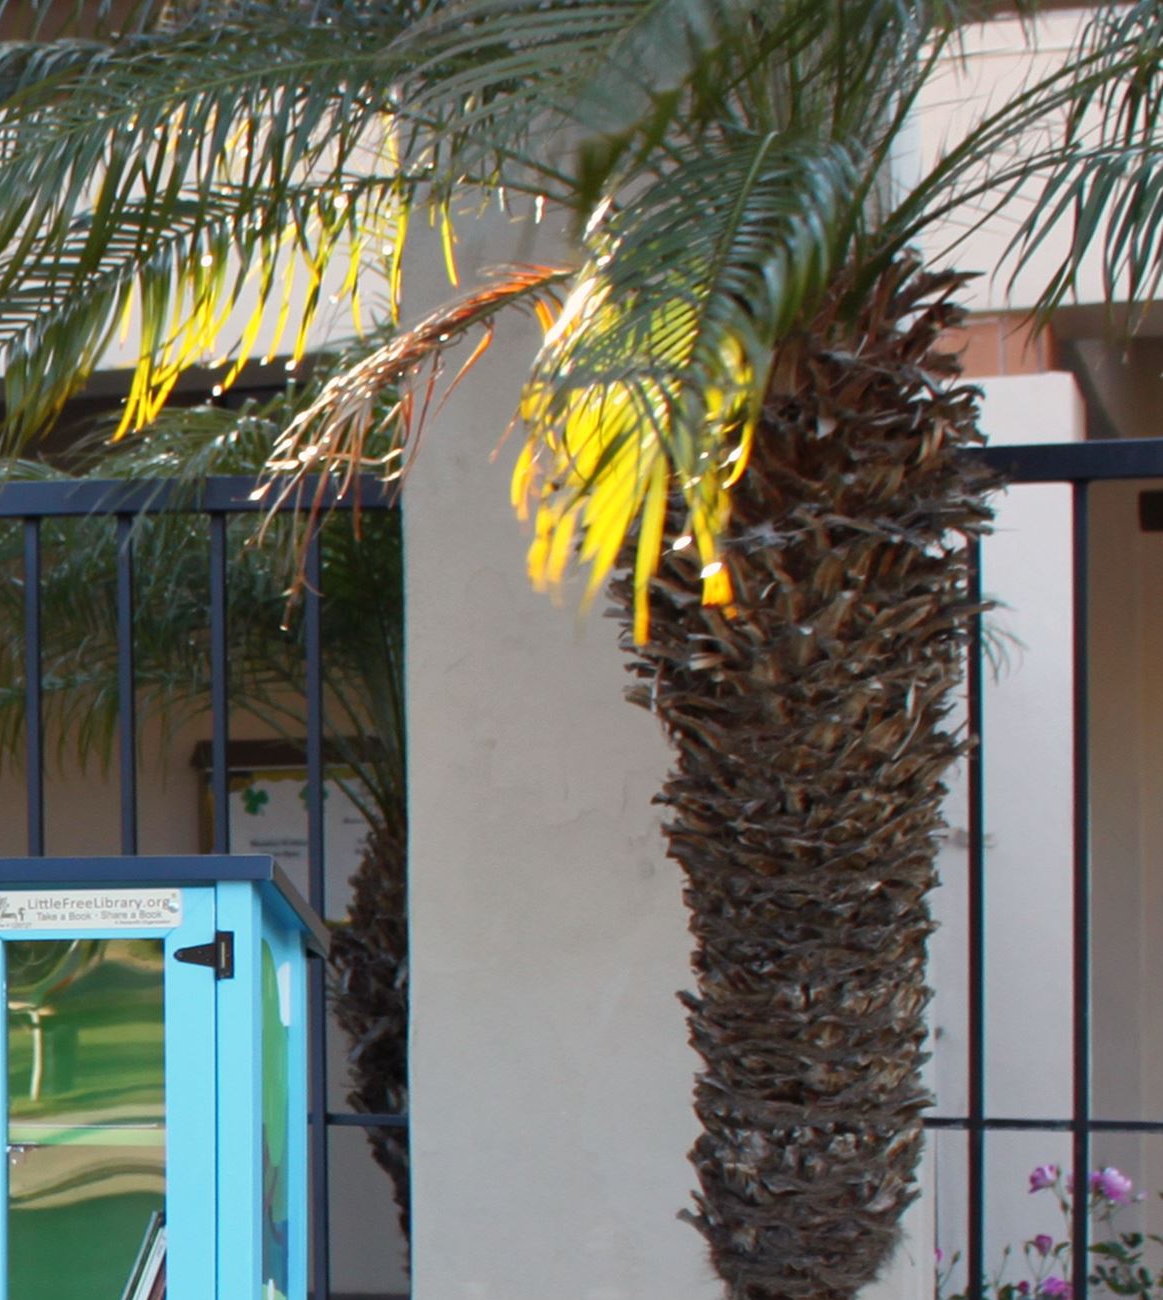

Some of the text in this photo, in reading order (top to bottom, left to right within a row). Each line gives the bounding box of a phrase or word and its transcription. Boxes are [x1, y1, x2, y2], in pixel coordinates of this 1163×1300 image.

[28, 897, 170, 910] LittleFreeLibrary.org
[37, 912, 57, 921] Take
[68, 911, 91, 921] Book
[101, 910, 128, 920] Share
[139, 910, 162, 919] Book
